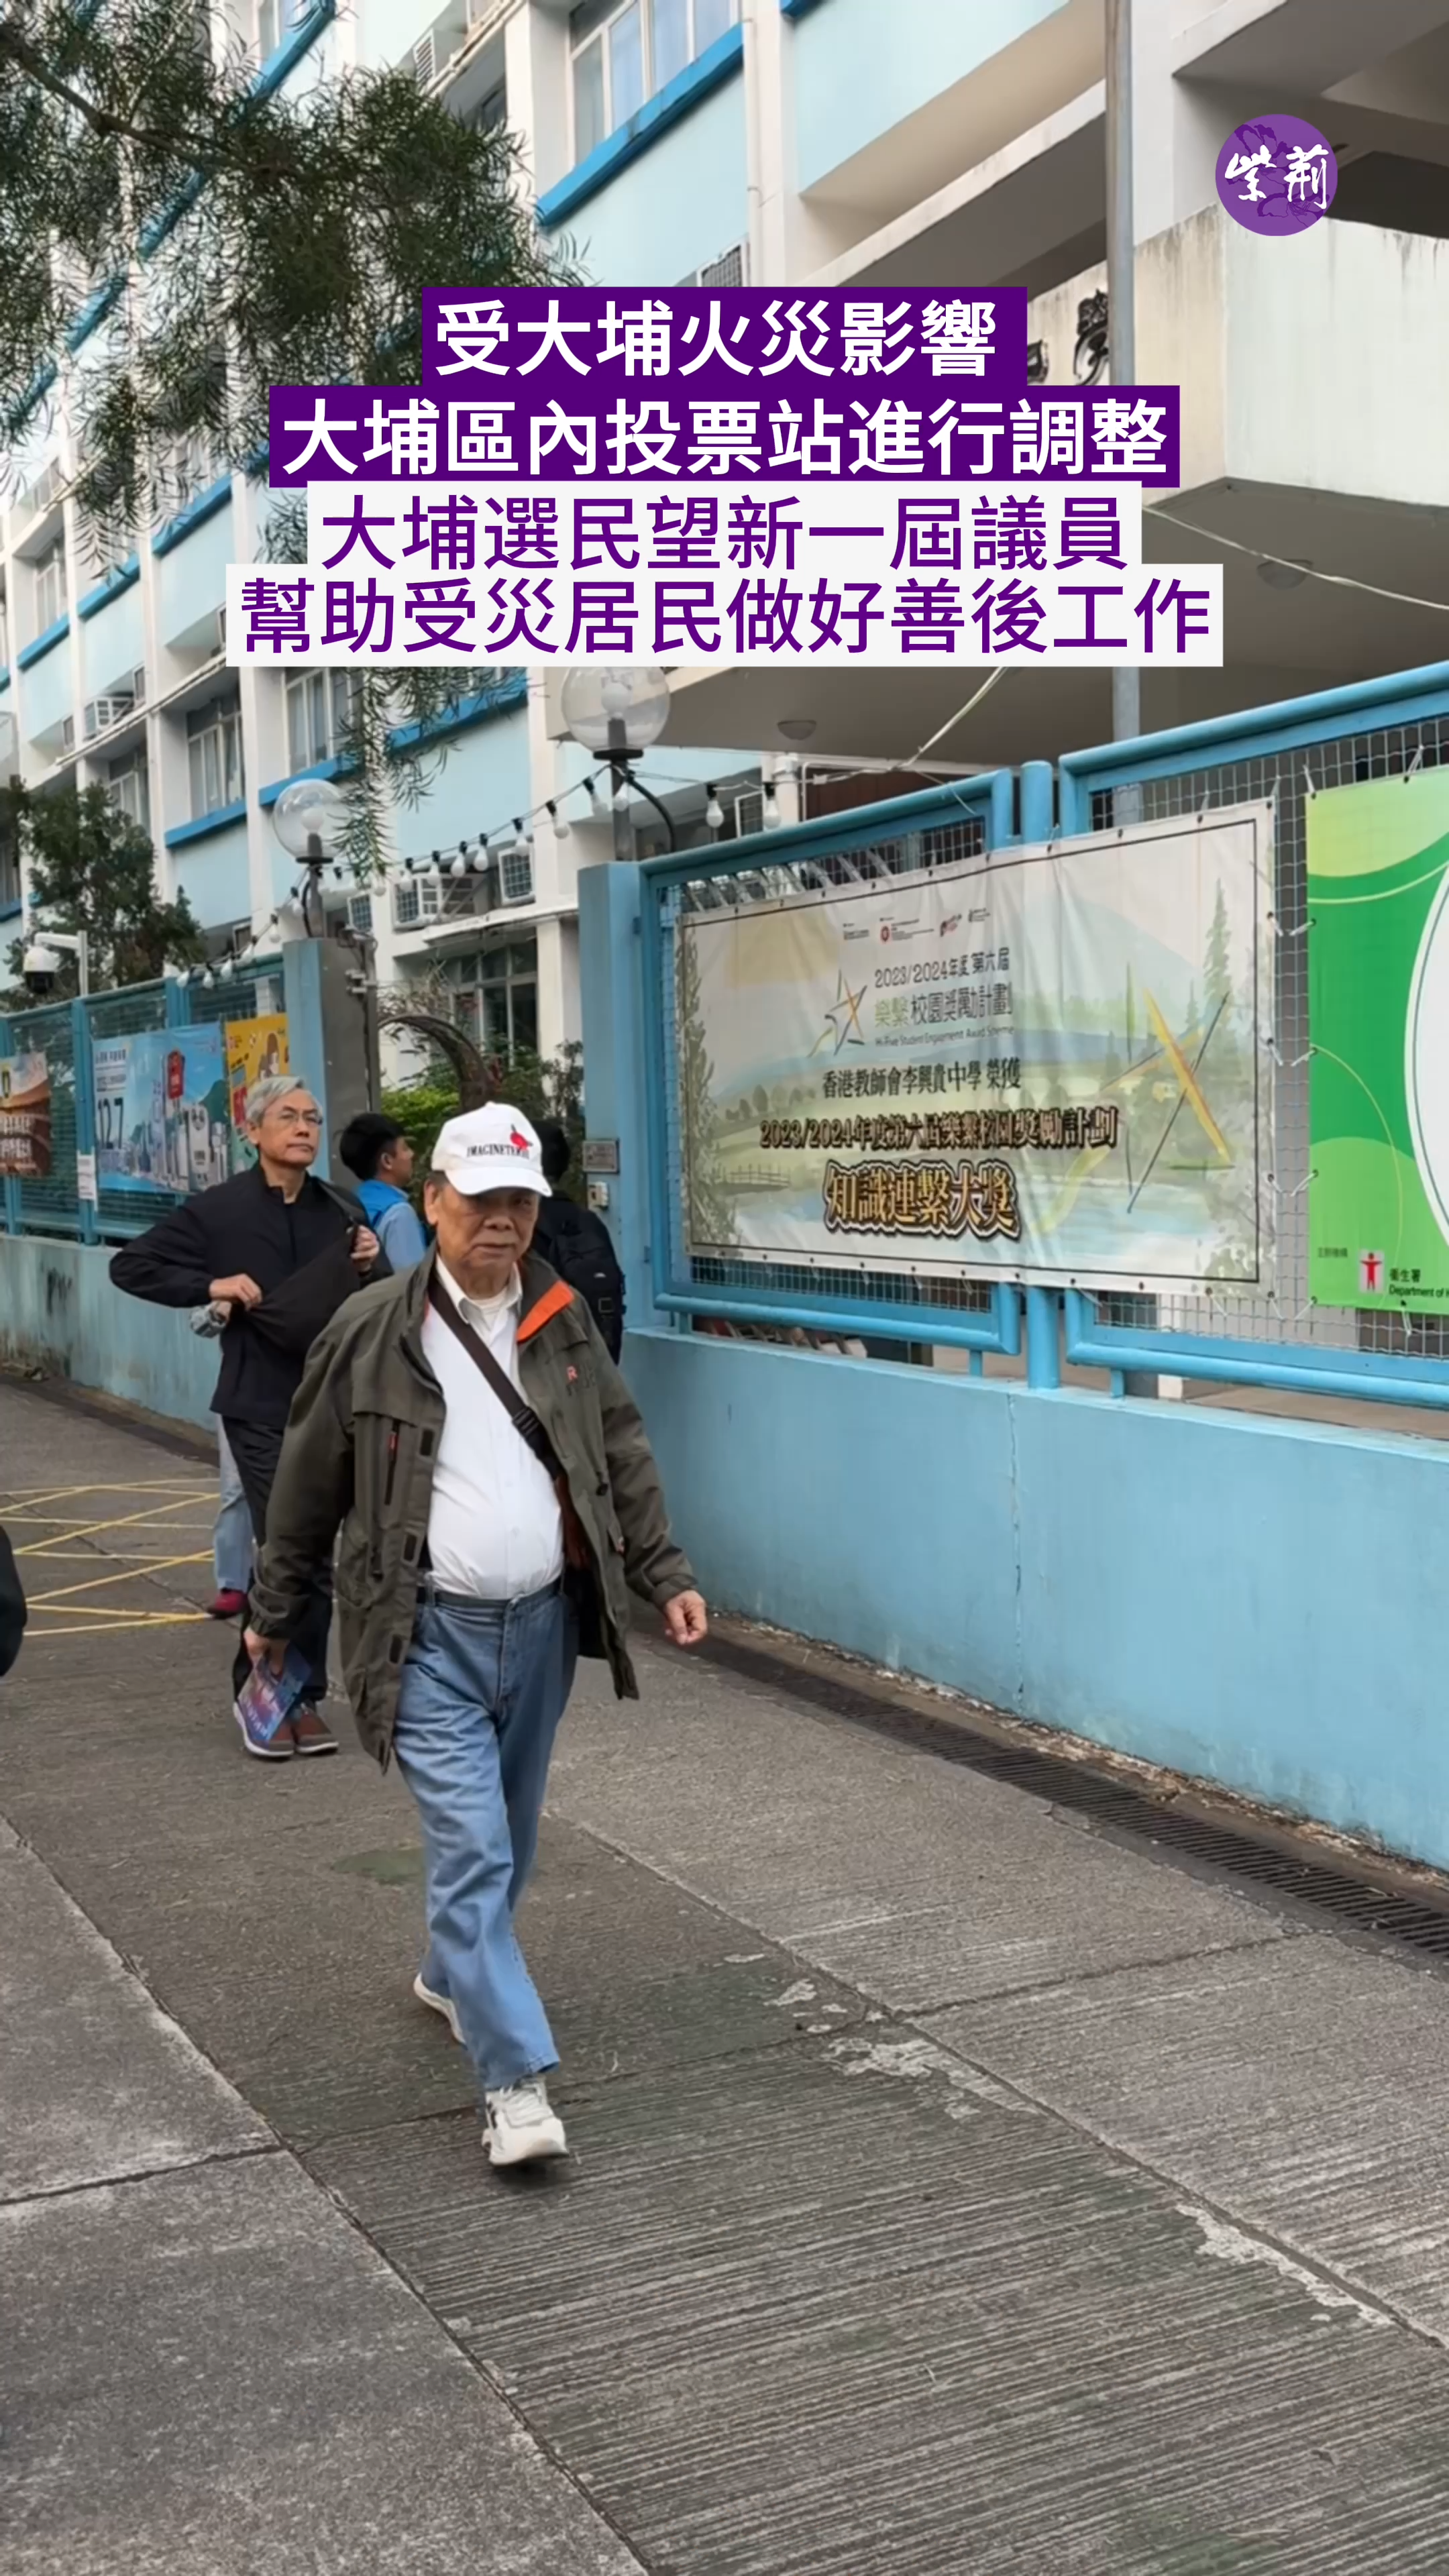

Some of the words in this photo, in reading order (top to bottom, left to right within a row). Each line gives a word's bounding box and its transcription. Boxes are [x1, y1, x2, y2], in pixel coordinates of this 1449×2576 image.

[824, 1163, 1017, 1234] 知識連繫大獎
[1389, 1284, 1434, 1297] Department
